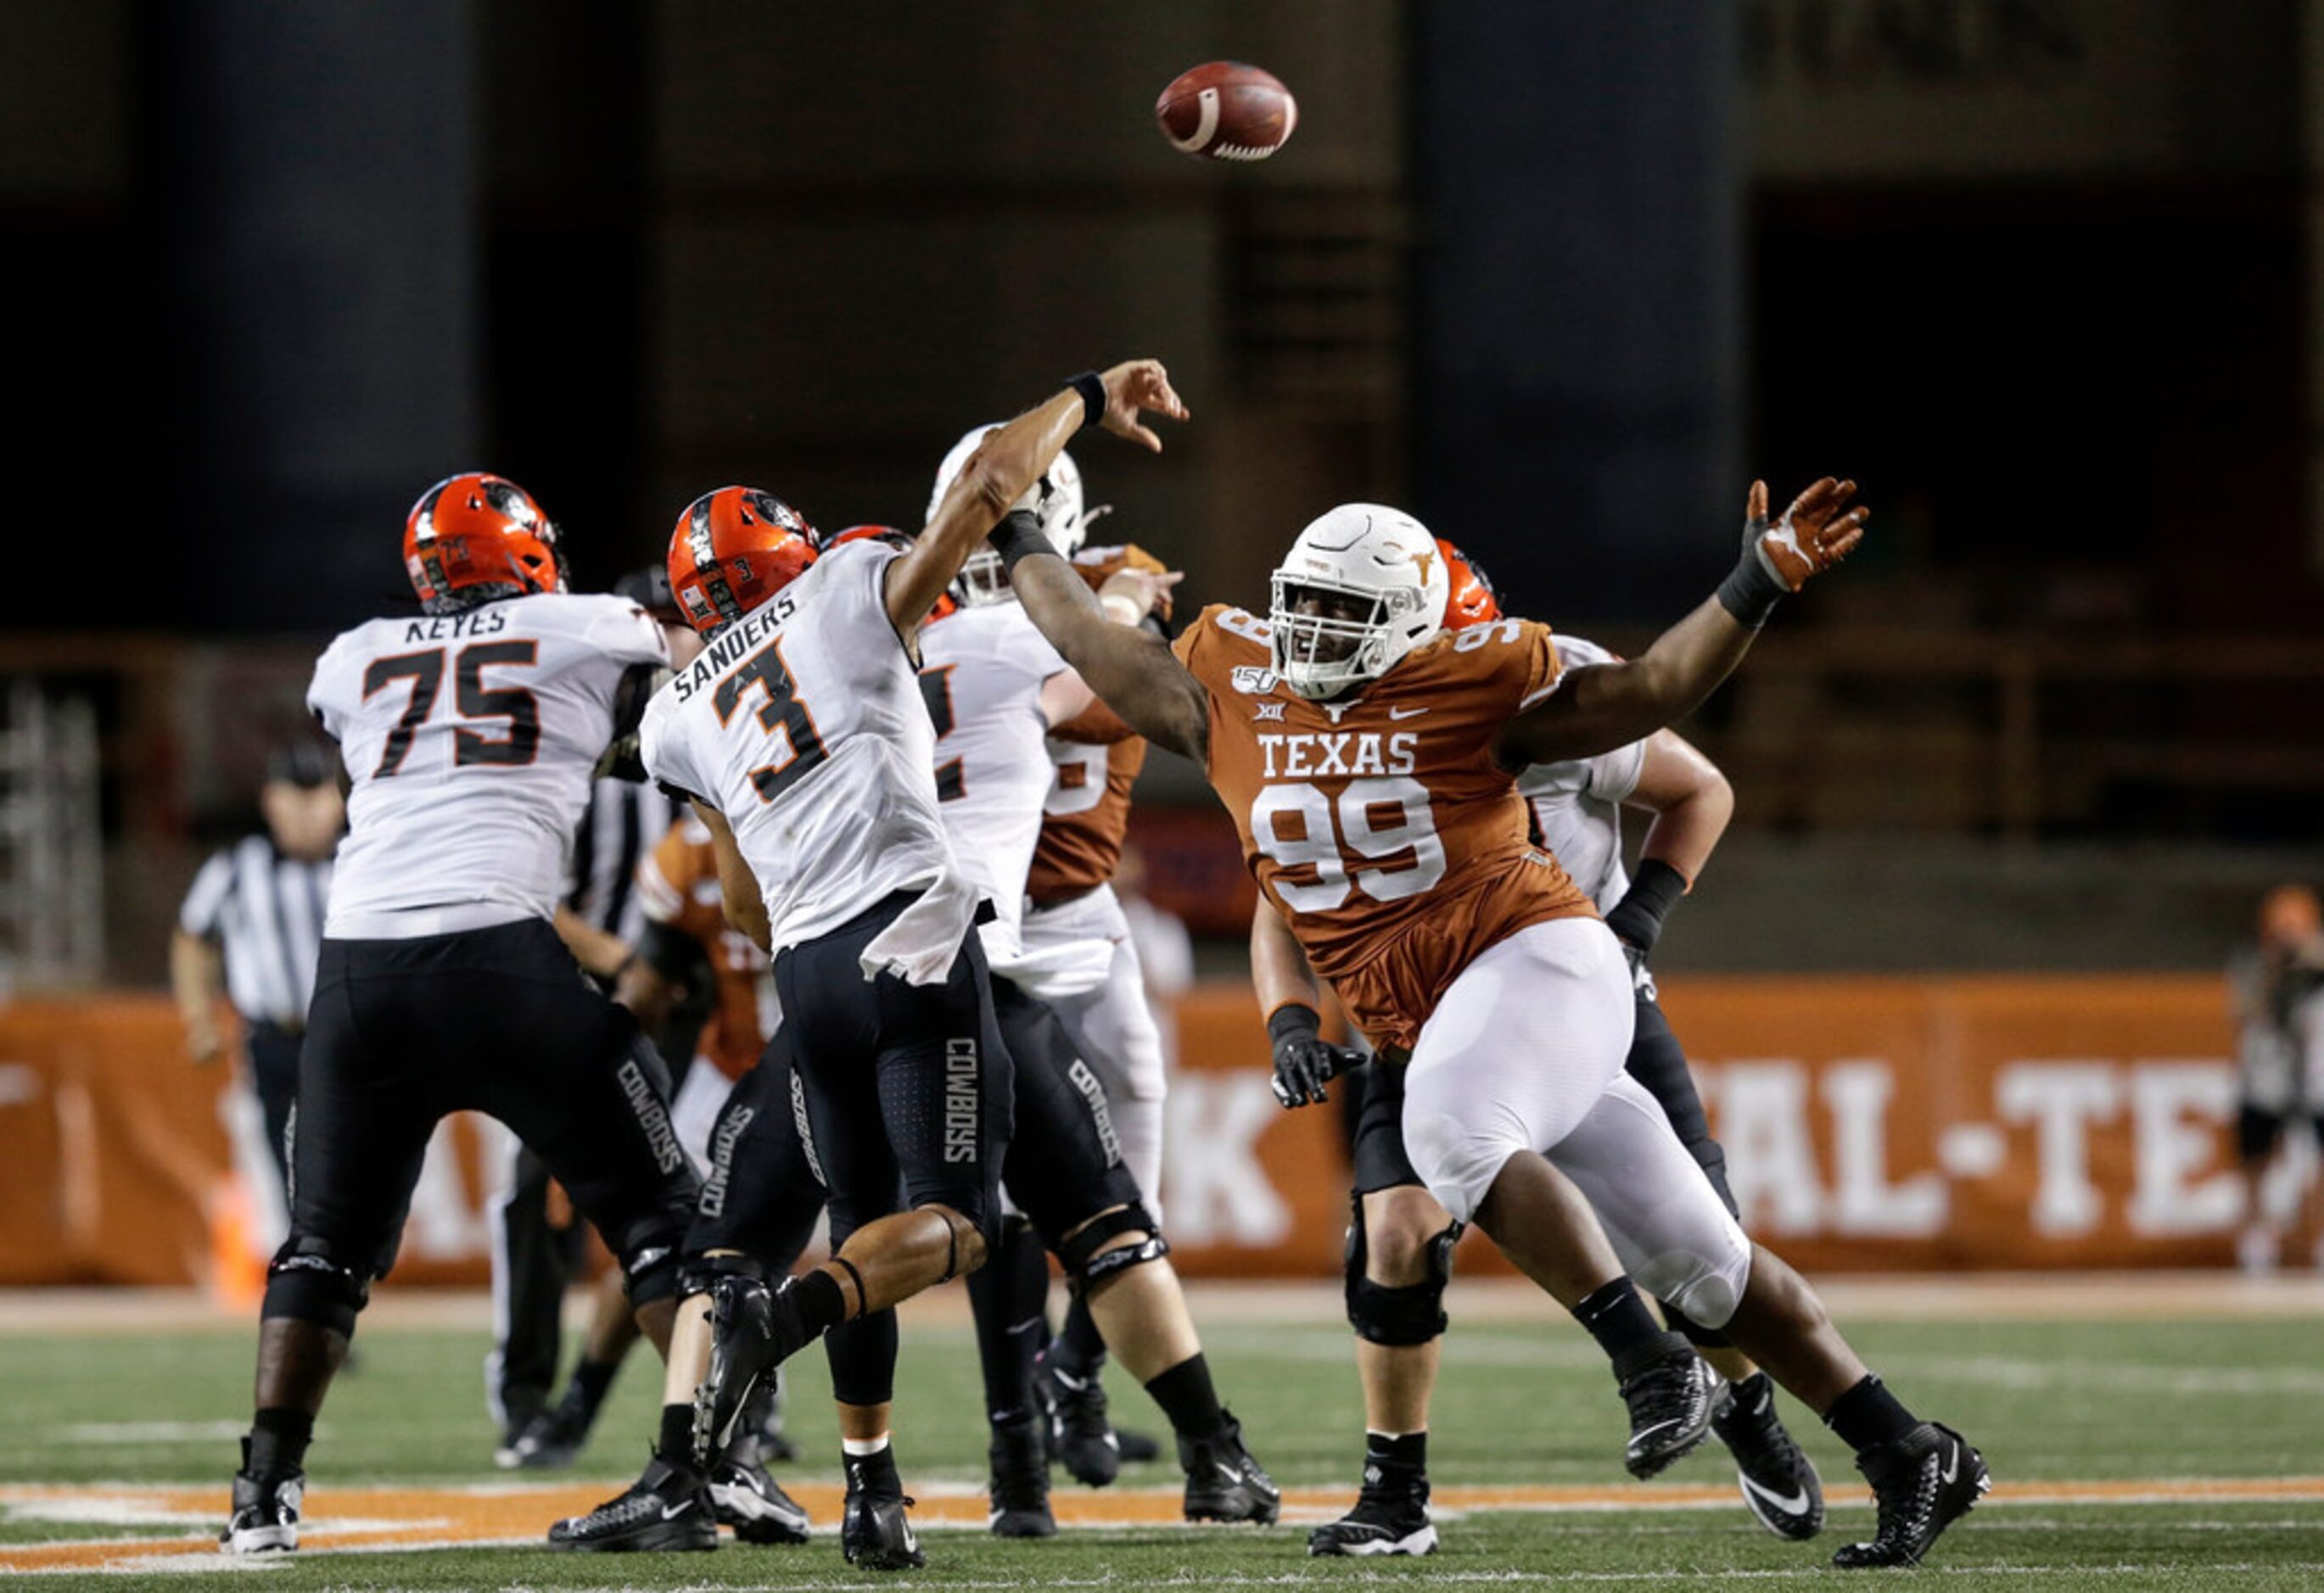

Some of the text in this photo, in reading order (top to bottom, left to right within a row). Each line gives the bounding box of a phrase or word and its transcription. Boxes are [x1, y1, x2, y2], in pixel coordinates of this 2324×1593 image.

[733, 557, 753, 583] 3
[405, 612, 507, 644] KEYES
[674, 592, 797, 704] SANDERS
[361, 638, 540, 778] 75
[711, 632, 831, 805] 3
[1257, 732, 1418, 778] TEXAS
[1250, 776, 1447, 914] 99
[617, 1059, 683, 1177] COWBOYS
[944, 1037, 977, 1163] COWBOYS
[698, 1104, 754, 1217] COWBOYS
